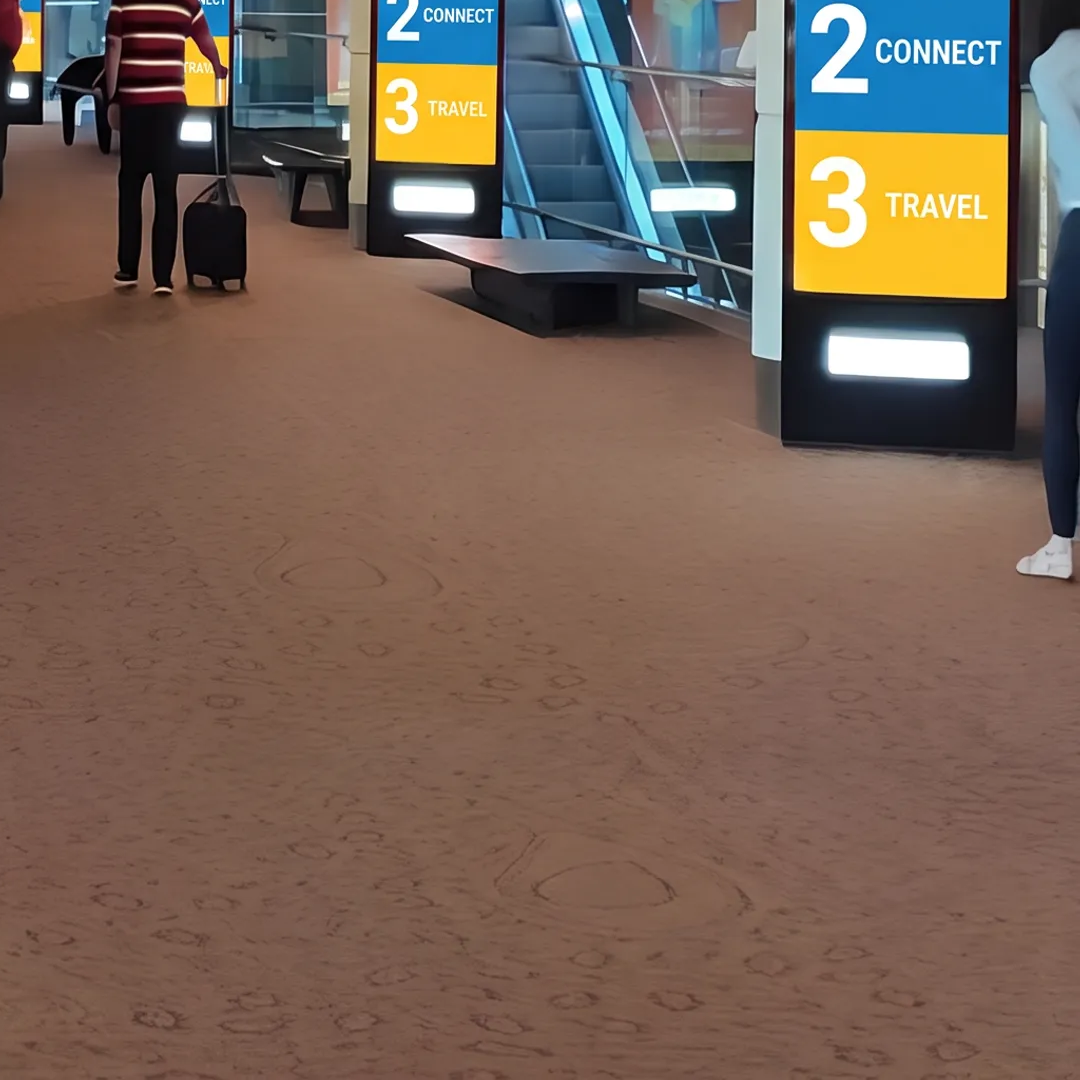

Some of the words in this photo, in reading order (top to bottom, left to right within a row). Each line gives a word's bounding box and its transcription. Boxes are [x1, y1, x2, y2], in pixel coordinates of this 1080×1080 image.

[423, 6, 495, 24] CONNECT
[810, 3, 869, 94] 2
[875, 38, 1002, 66] CONNECT
[384, 77, 419, 135] 3
[427, 99, 488, 118] TRAVEL
[808, 155, 868, 249] 3
[885, 192, 989, 220] TRAVEL
